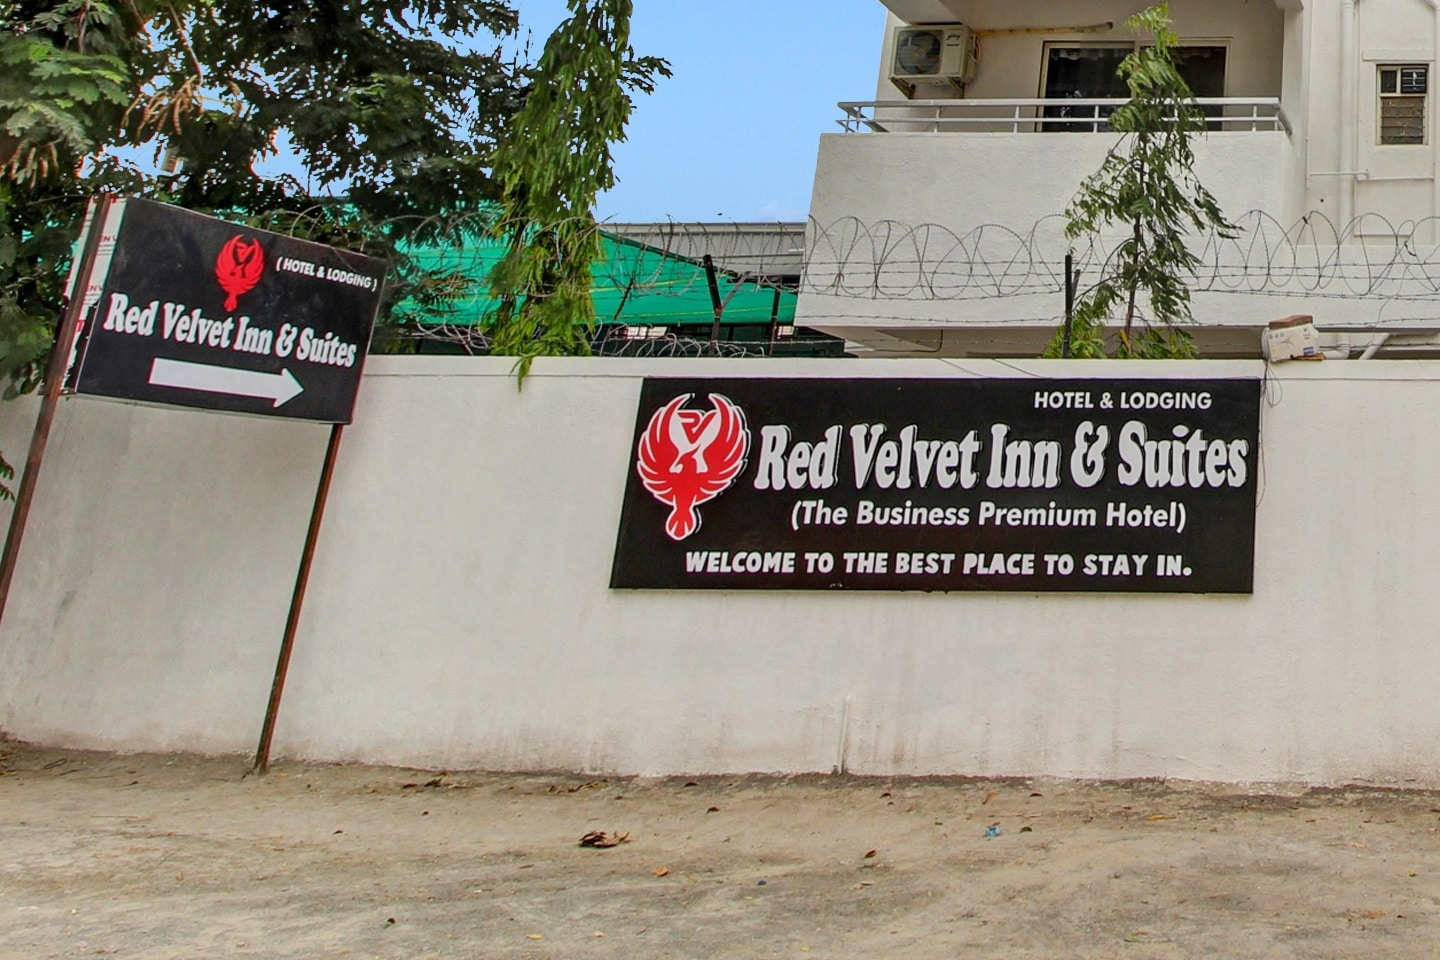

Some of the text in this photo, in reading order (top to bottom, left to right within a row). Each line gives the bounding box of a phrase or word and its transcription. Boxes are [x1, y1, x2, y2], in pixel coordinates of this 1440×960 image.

[316, 265, 325, 279] &
[104, 293, 159, 336] Red
[163, 302, 233, 349] Velvet
[235, 316, 272, 356] Inn
[276, 322, 297, 358] &
[296, 327, 358, 368] Suites
[1034, 391, 1212, 410] HOTEL & LODGING
[754, 420, 1249, 490] Red Velvet Inn & Suites
[790, 499, 1187, 533] (The Business Premium Hotel)
[685, 551, 1192, 576] WELCOME TO THE BEST PLACE TO STAY IN.
